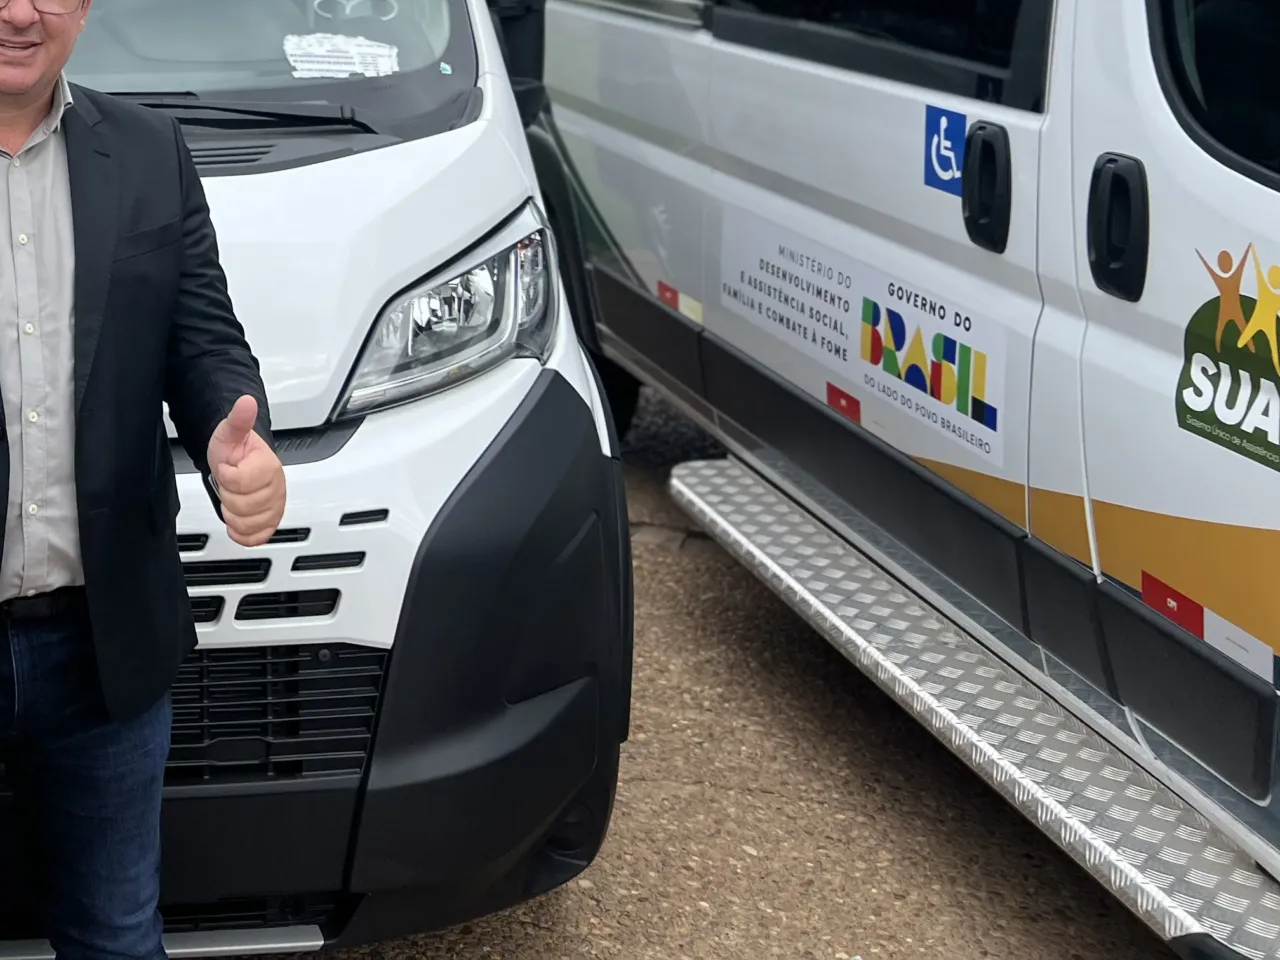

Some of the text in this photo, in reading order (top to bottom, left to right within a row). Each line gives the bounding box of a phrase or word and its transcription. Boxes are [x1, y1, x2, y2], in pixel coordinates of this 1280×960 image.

[759, 258, 850, 313] DESENVOLVIMENTO
[778, 244, 852, 289] MINISTÉRIO DO
[722, 282, 756, 310] FAMÍLIA
[758, 301, 763, 315] E
[765, 306, 808, 340] COMBATE
[821, 336, 848, 362] FOME
[740, 270, 848, 340] E ASSISTÊNCIA SOCIAL,
[888, 282, 972, 332] GOVERNO DO
[860, 296, 998, 432] BRASIL
[864, 373, 992, 454] DO LADO DO POVO BRASILEIRO
